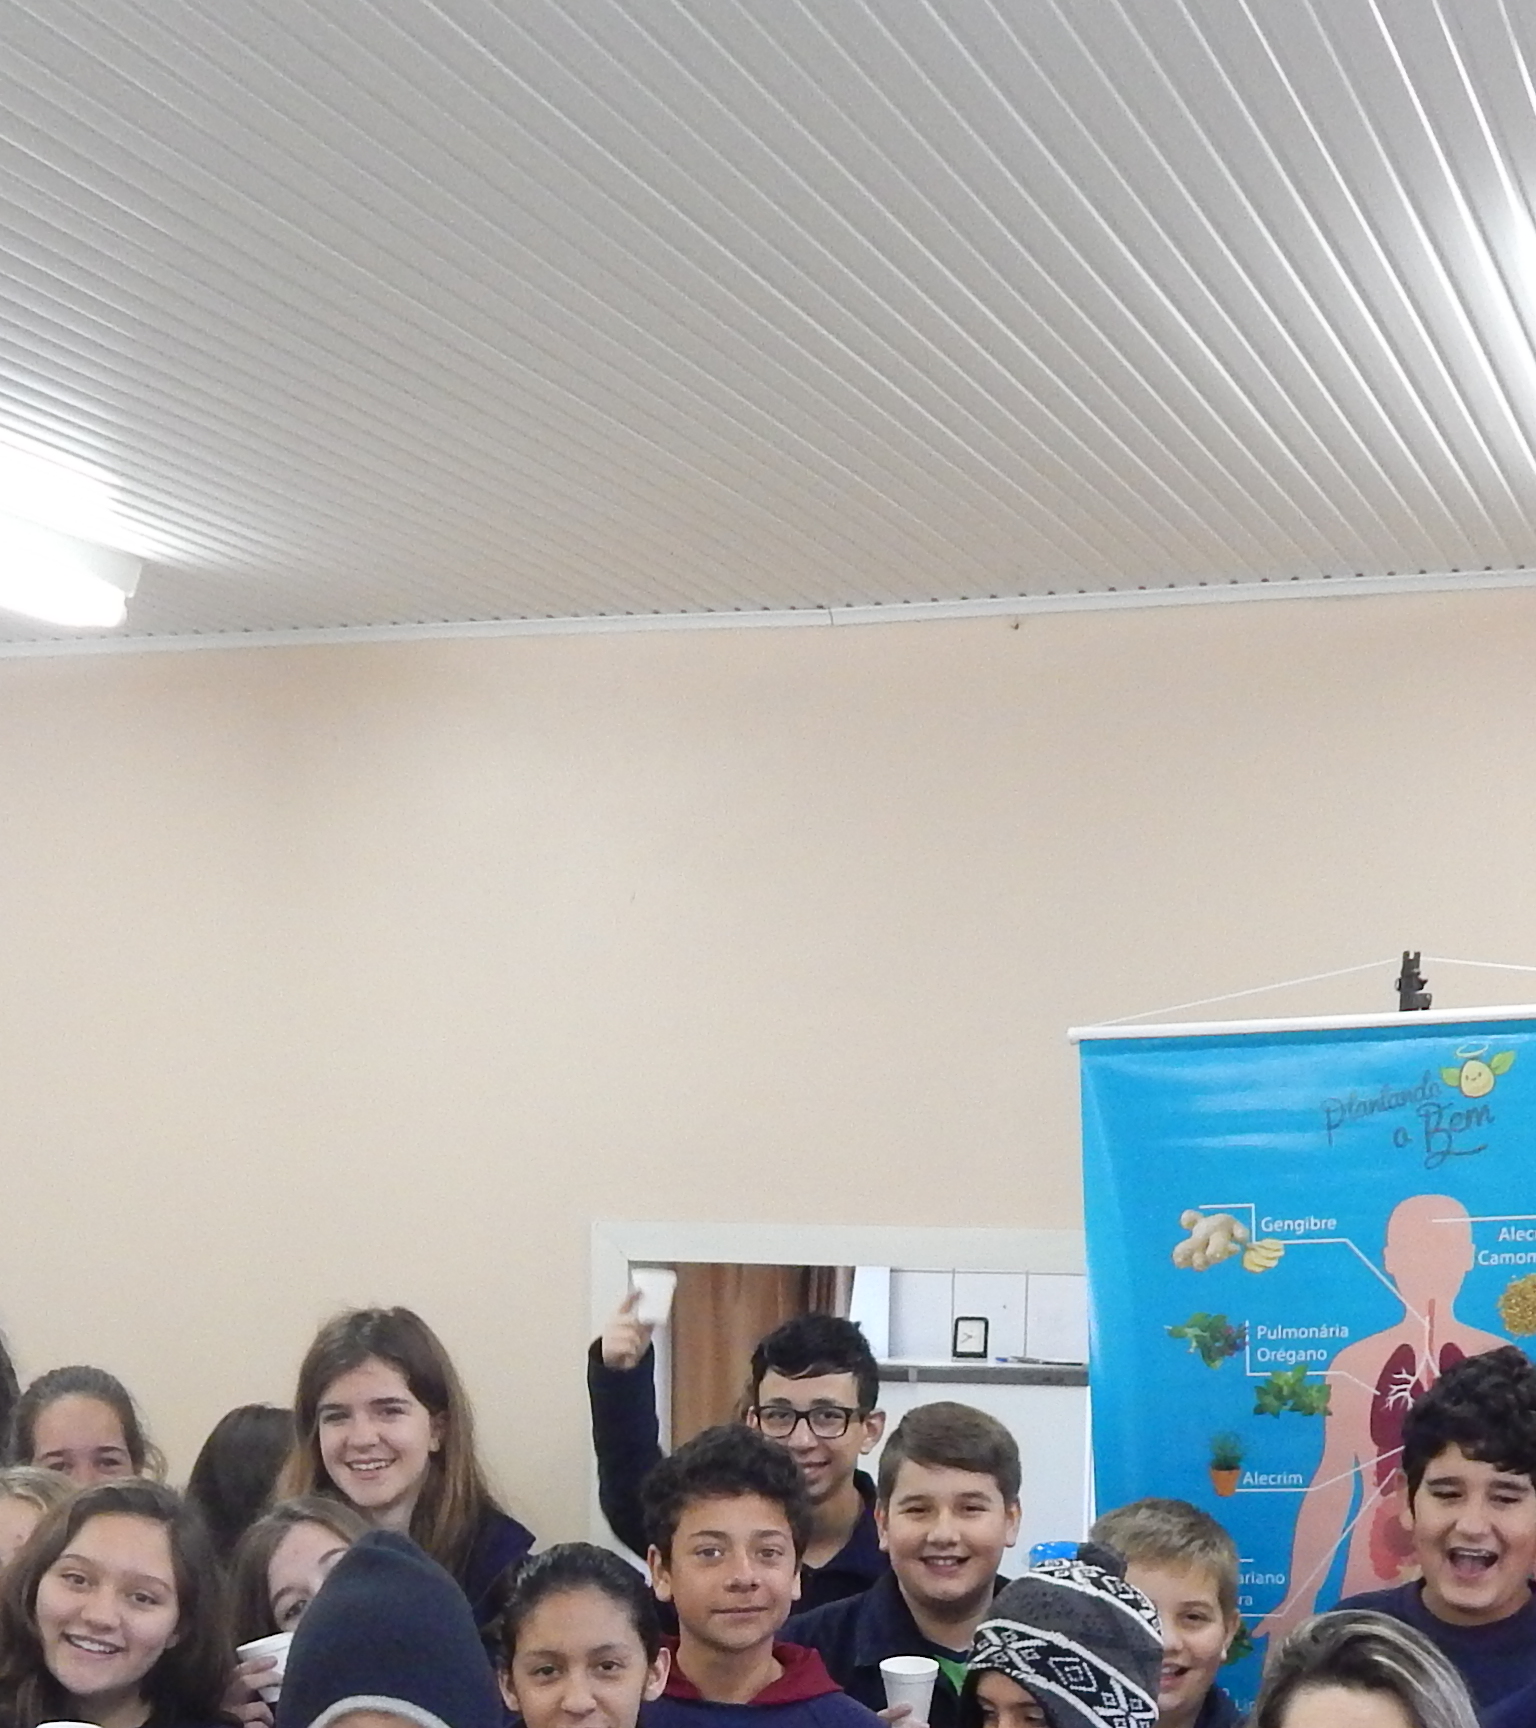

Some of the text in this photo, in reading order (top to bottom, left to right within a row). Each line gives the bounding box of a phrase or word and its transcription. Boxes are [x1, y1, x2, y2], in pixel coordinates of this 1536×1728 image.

[1260, 1215, 1338, 1235] Gengibre
[1256, 1323, 1350, 1341] Pulmonária
[1256, 1347, 1328, 1365] Orégano
[1242, 1471, 1303, 1486] Alecrim
[1237, 1571, 1286, 1585] ariano
